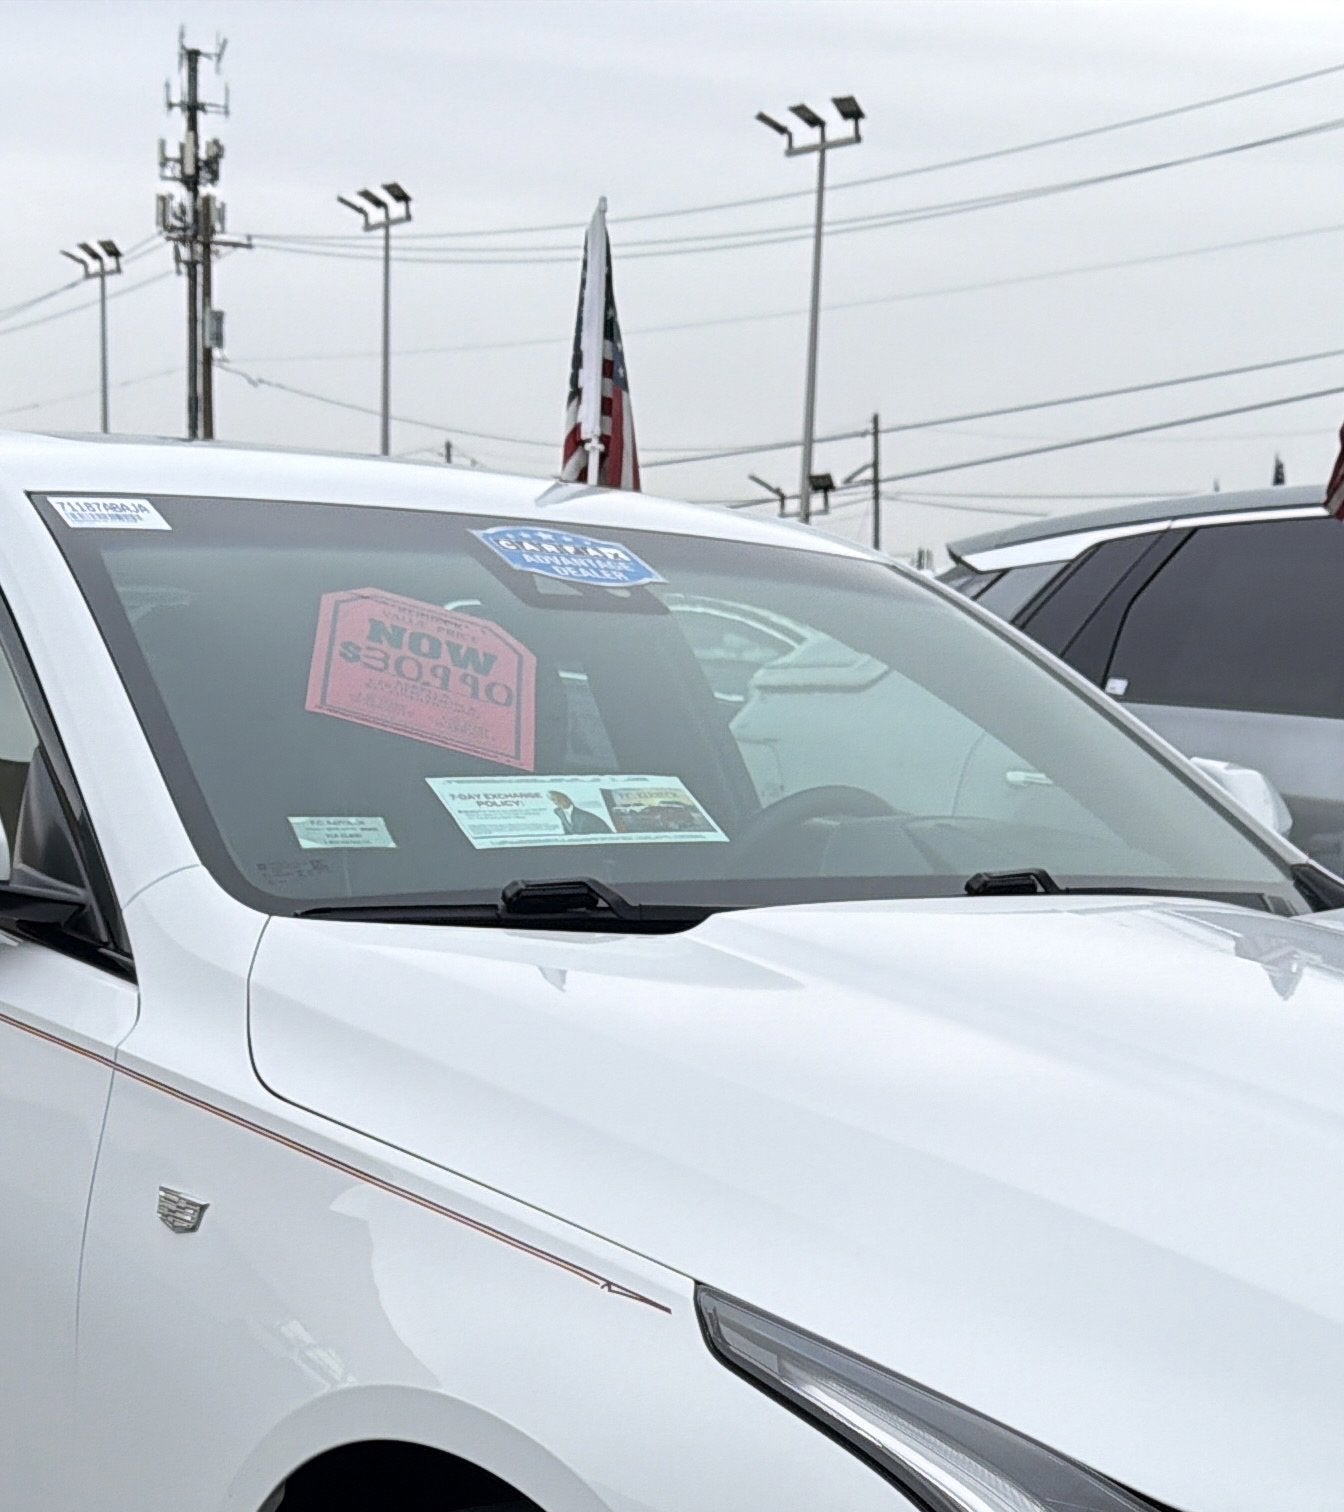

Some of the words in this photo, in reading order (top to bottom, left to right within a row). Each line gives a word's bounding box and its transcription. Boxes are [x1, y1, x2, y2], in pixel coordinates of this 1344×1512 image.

[497, 538, 632, 562] CARFAX
[522, 553, 635, 572] ADVANTAGE
[553, 565, 629, 581] DEALER
[366, 617, 498, 677] NOW
